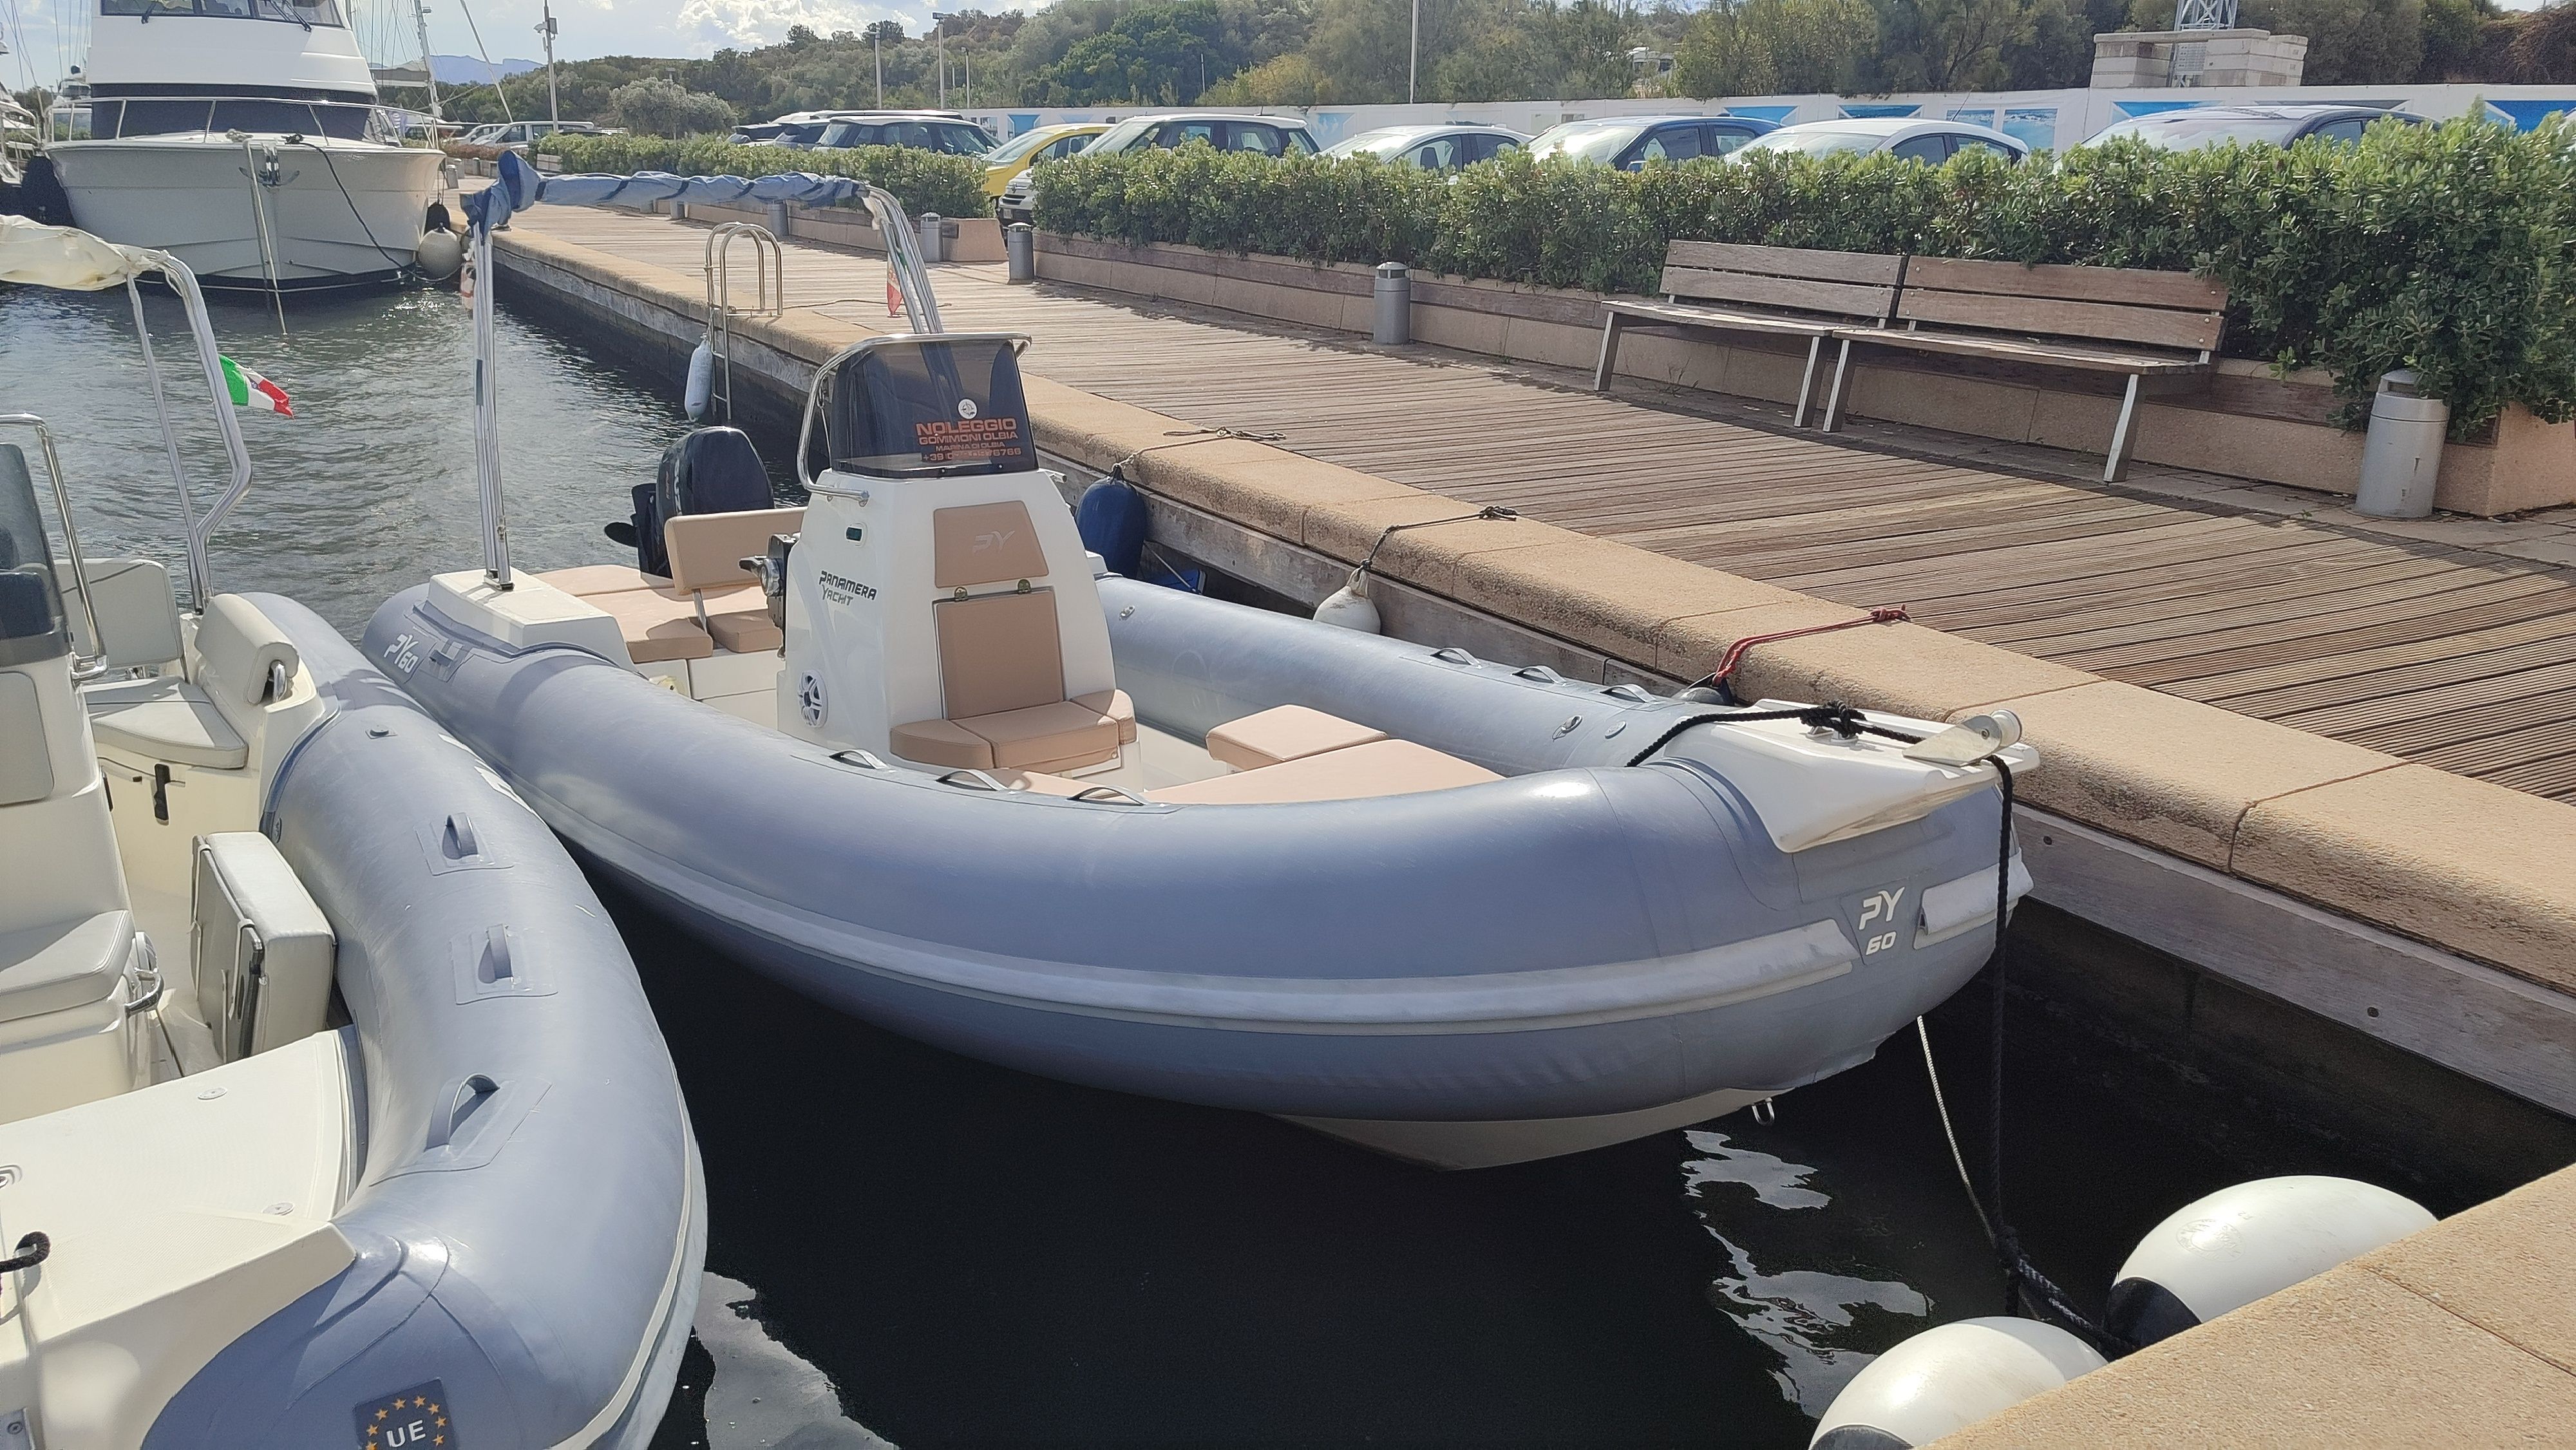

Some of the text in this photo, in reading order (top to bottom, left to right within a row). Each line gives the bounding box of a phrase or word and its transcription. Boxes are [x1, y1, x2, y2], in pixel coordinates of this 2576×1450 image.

[916, 419, 1016, 435] NOLEGGIO
[983, 431, 1018, 440] OLBIA
[972, 531, 1015, 556] PY
[819, 570, 876, 600] PANAMERA
[822, 584, 853, 605] YACHT
[384, 634, 419, 664] PY
[398, 651, 419, 673] 60
[1859, 887, 1905, 930] PY
[1866, 931, 1897, 956] 60
[386, 1420, 426, 1447] UE
